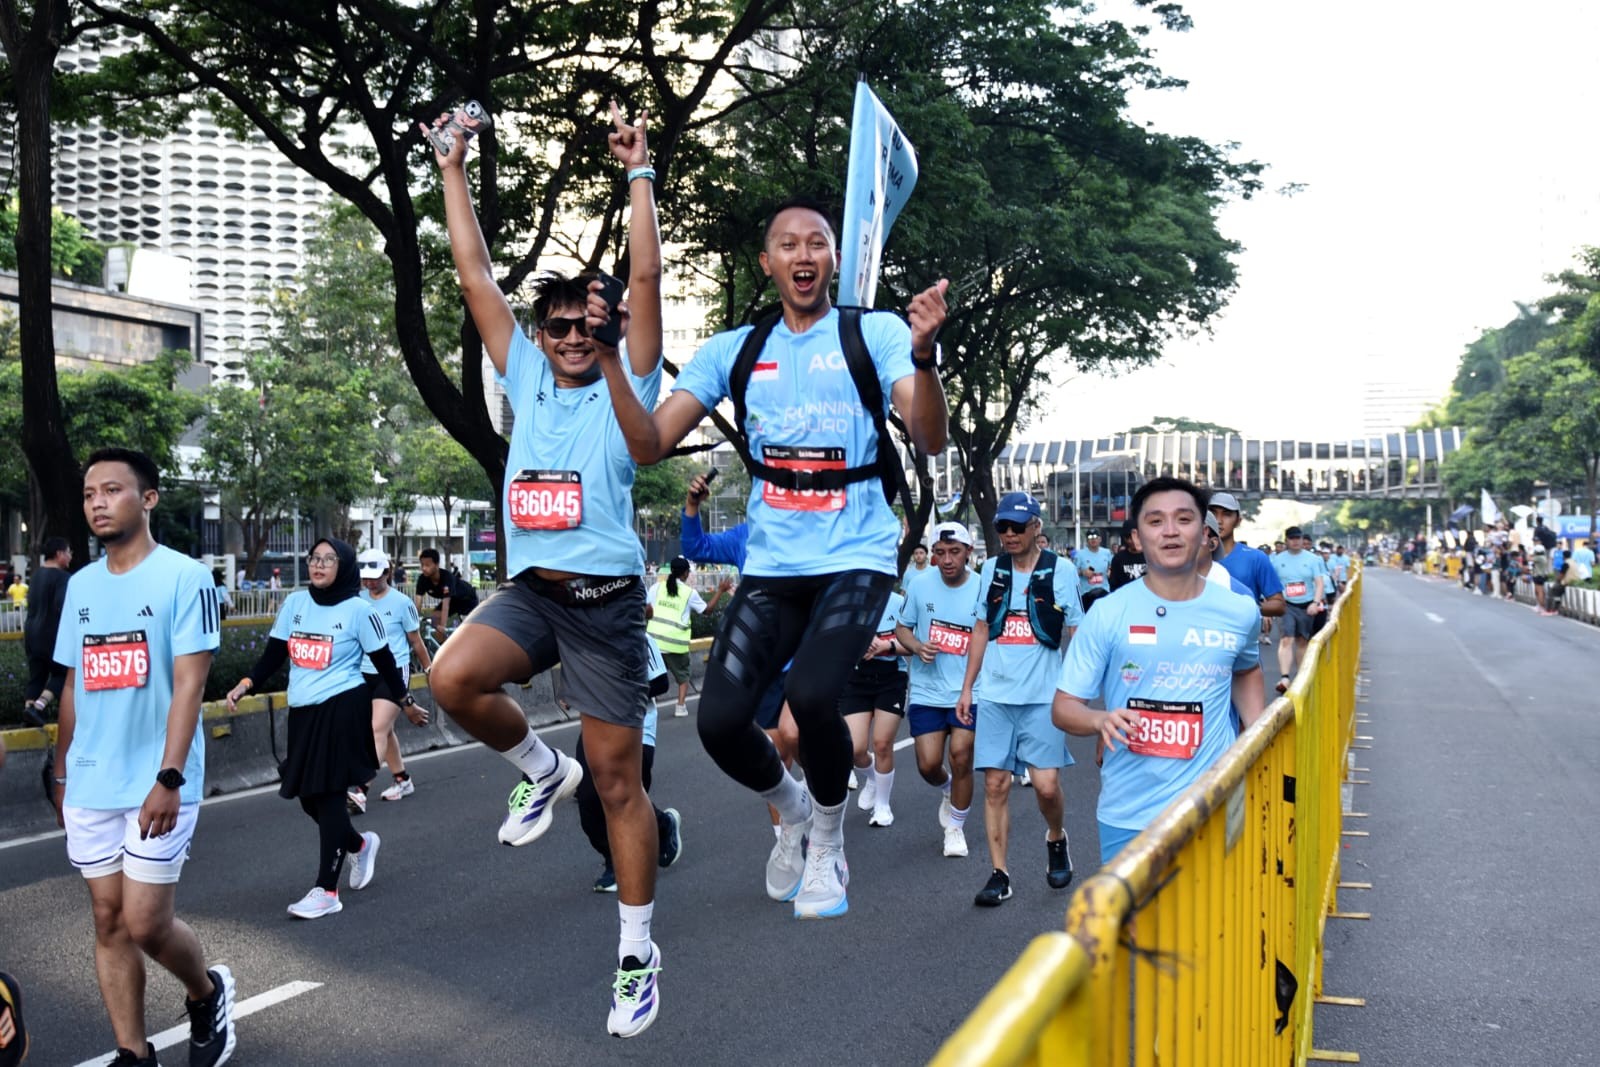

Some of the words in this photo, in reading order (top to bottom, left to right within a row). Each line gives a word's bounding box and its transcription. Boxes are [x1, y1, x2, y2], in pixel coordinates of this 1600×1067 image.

[518, 489, 579, 517] 36045
[575, 577, 632, 600] NOEXCUSE
[935, 630, 969, 649] 37951
[1182, 627, 1238, 650] ADR
[294, 642, 330, 662] 36471
[89, 649, 148, 679] 35576
[1139, 717, 1200, 747] 35901
